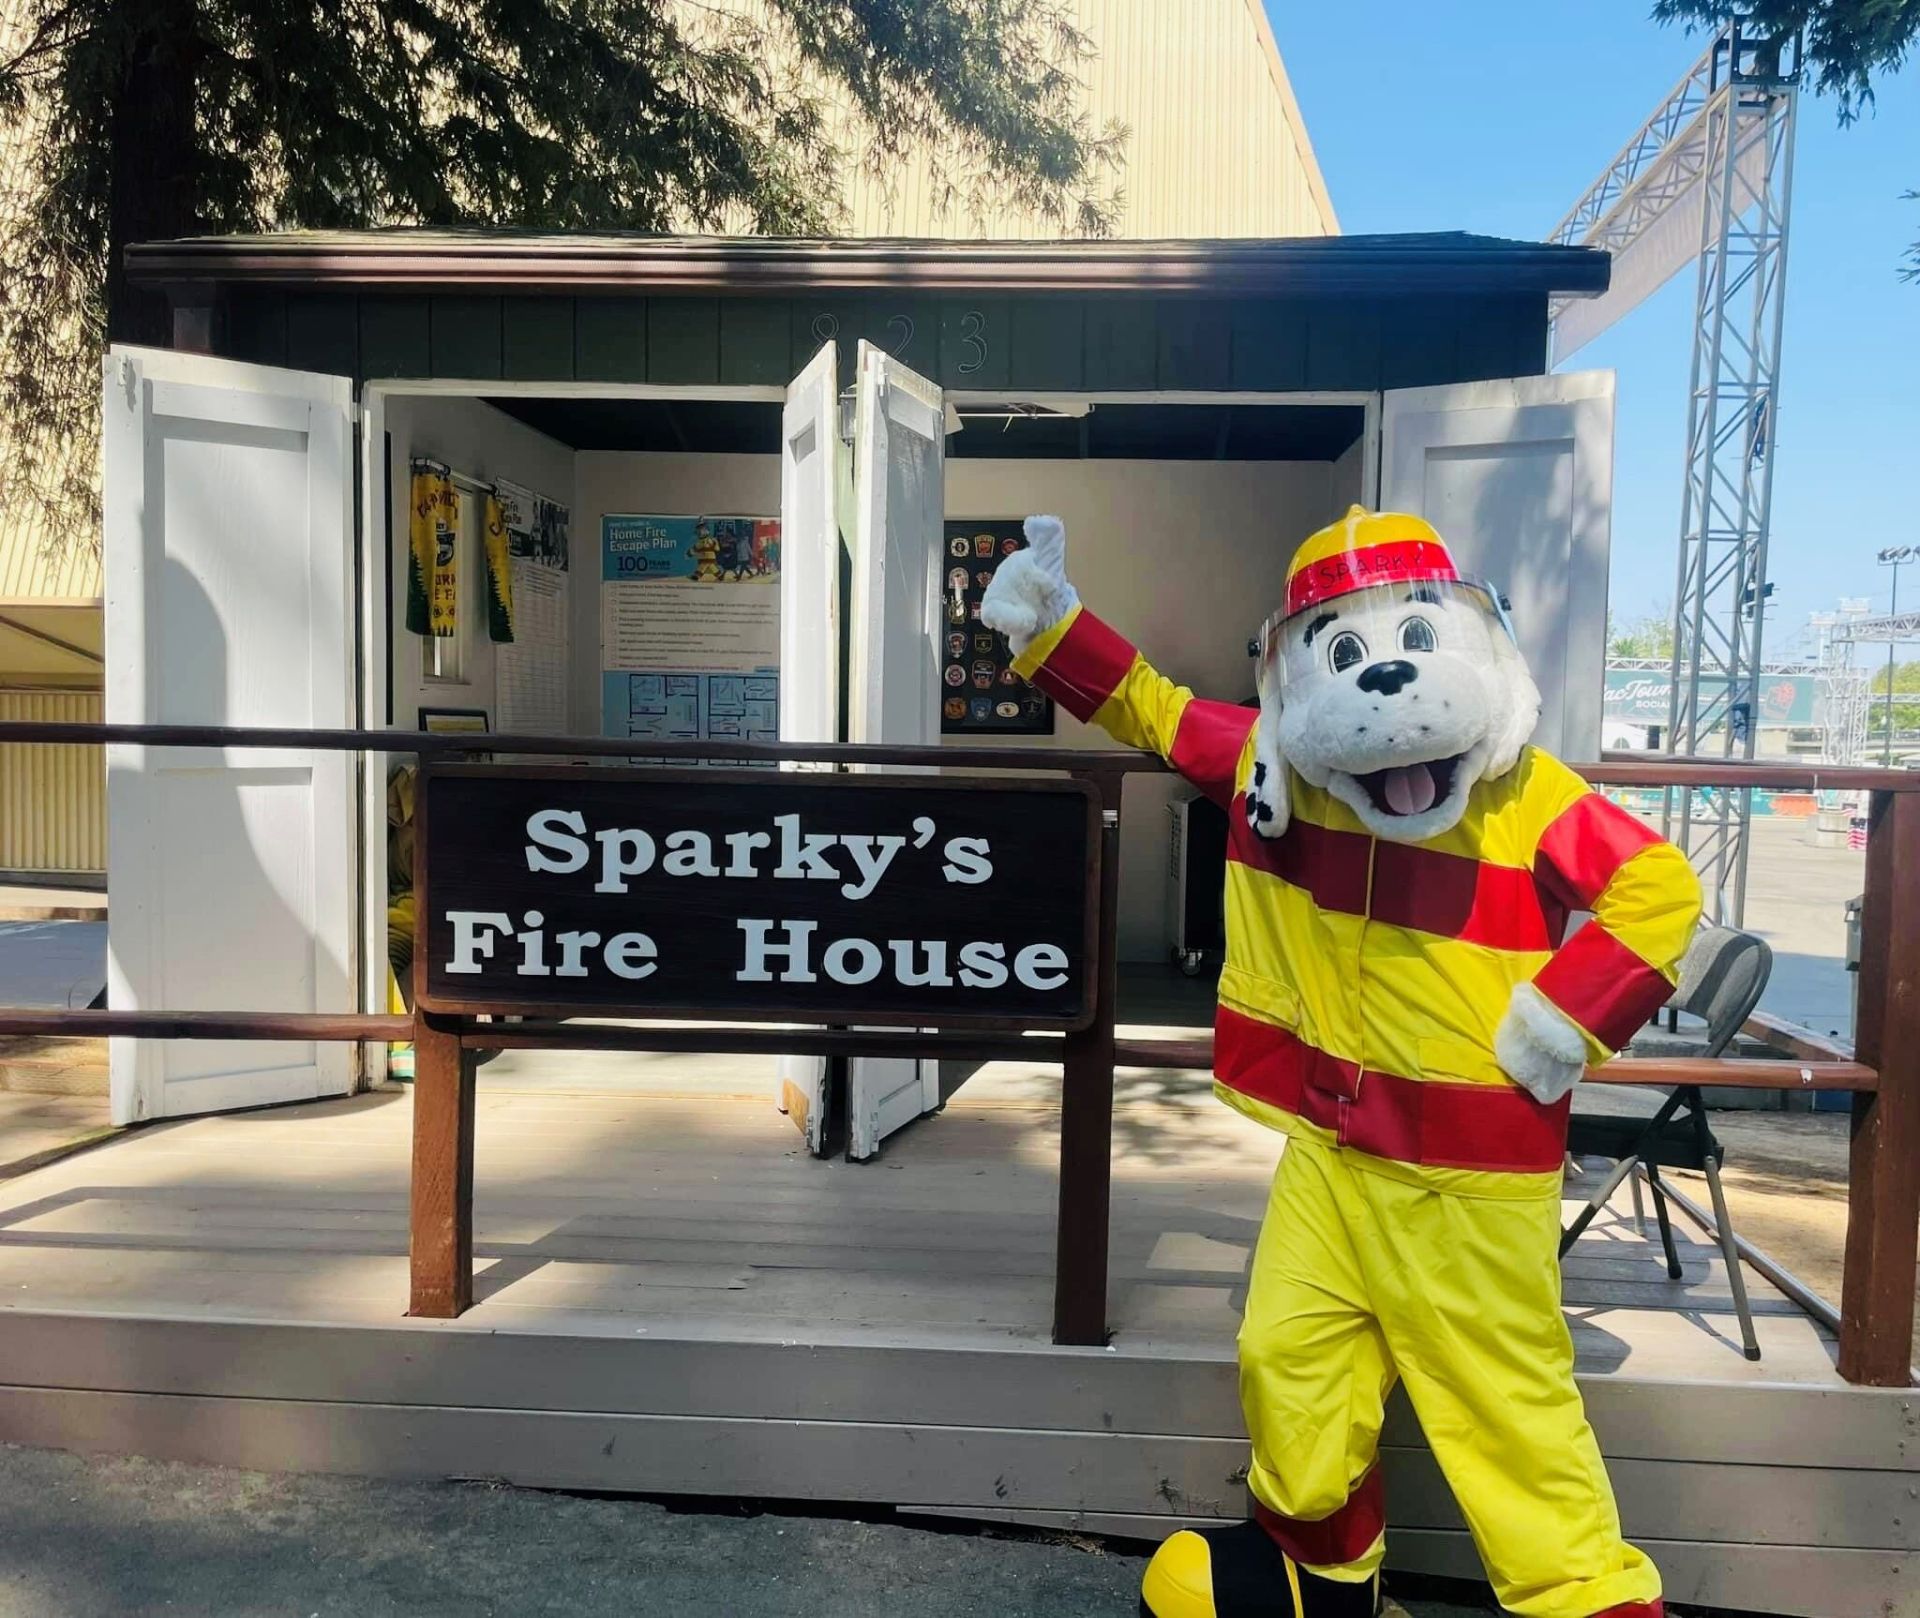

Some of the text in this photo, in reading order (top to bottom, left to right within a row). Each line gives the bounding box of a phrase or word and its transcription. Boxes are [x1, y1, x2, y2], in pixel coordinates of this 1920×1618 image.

[610, 526, 667, 540] Home Fire
[610, 538, 677, 553] Escape Plan
[618, 556, 648, 571] 100
[1321, 554, 1422, 588] SPARKY
[1604, 679, 1671, 701] acTown
[525, 809, 993, 900] Sparky's
[445, 910, 1069, 990] Fire House
